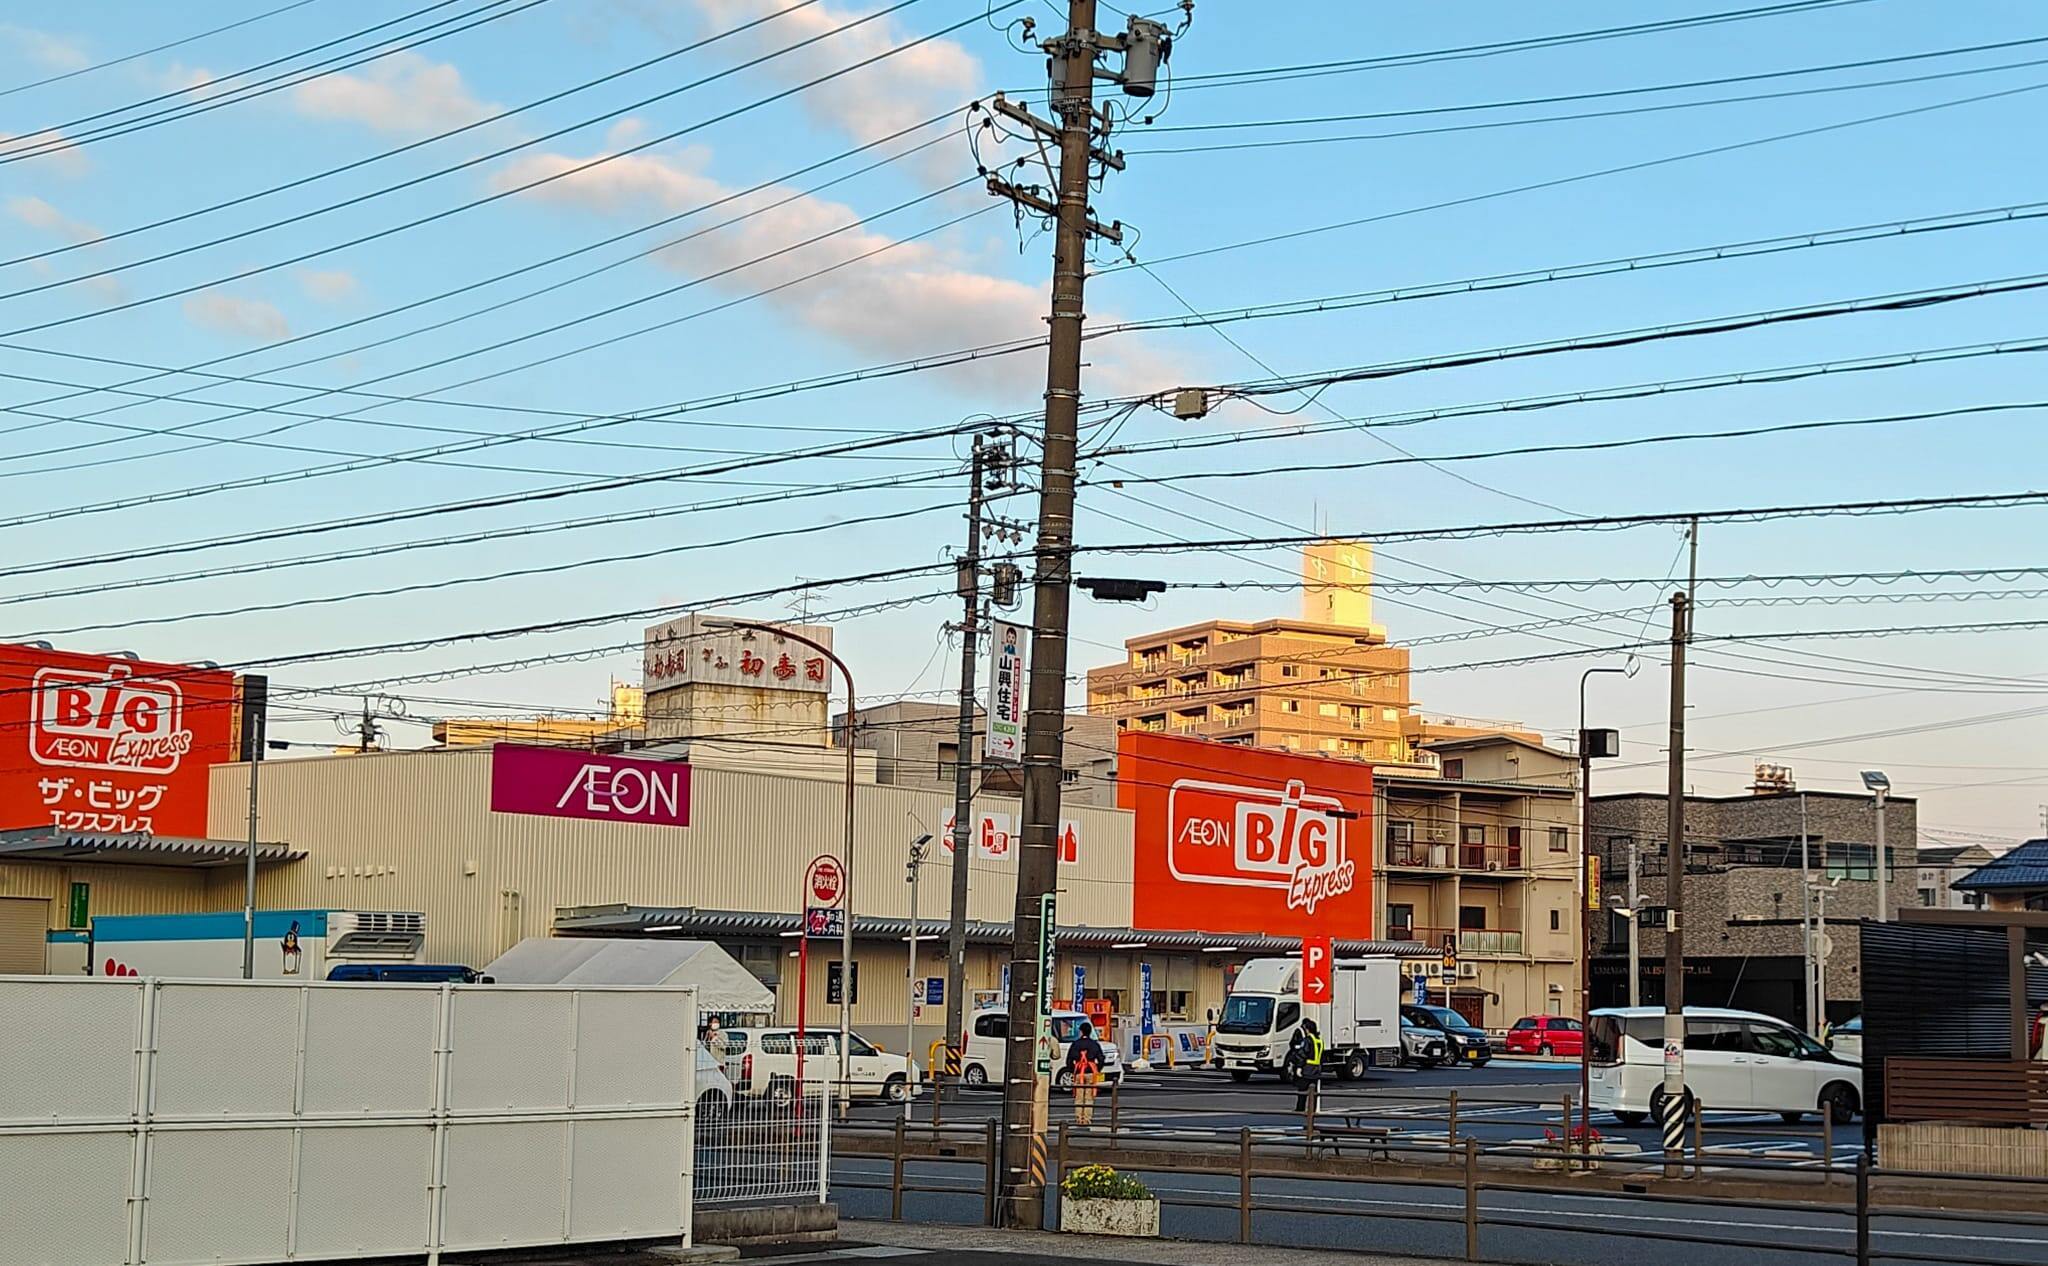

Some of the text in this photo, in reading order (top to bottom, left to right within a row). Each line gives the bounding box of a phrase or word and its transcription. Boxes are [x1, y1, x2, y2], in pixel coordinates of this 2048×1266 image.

[739, 650, 826, 683] 初寿司
[55, 672, 160, 734] BIG
[107, 730, 193, 768] Express
[37, 777, 169, 812] ザ・ビッグ
[49, 809, 155, 835] エクスプレス
[1246, 787, 1328, 867] BIG
[814, 874, 837, 890] 消火栓
[1288, 861, 1354, 915] Express
[1309, 946, 1323, 968] P
